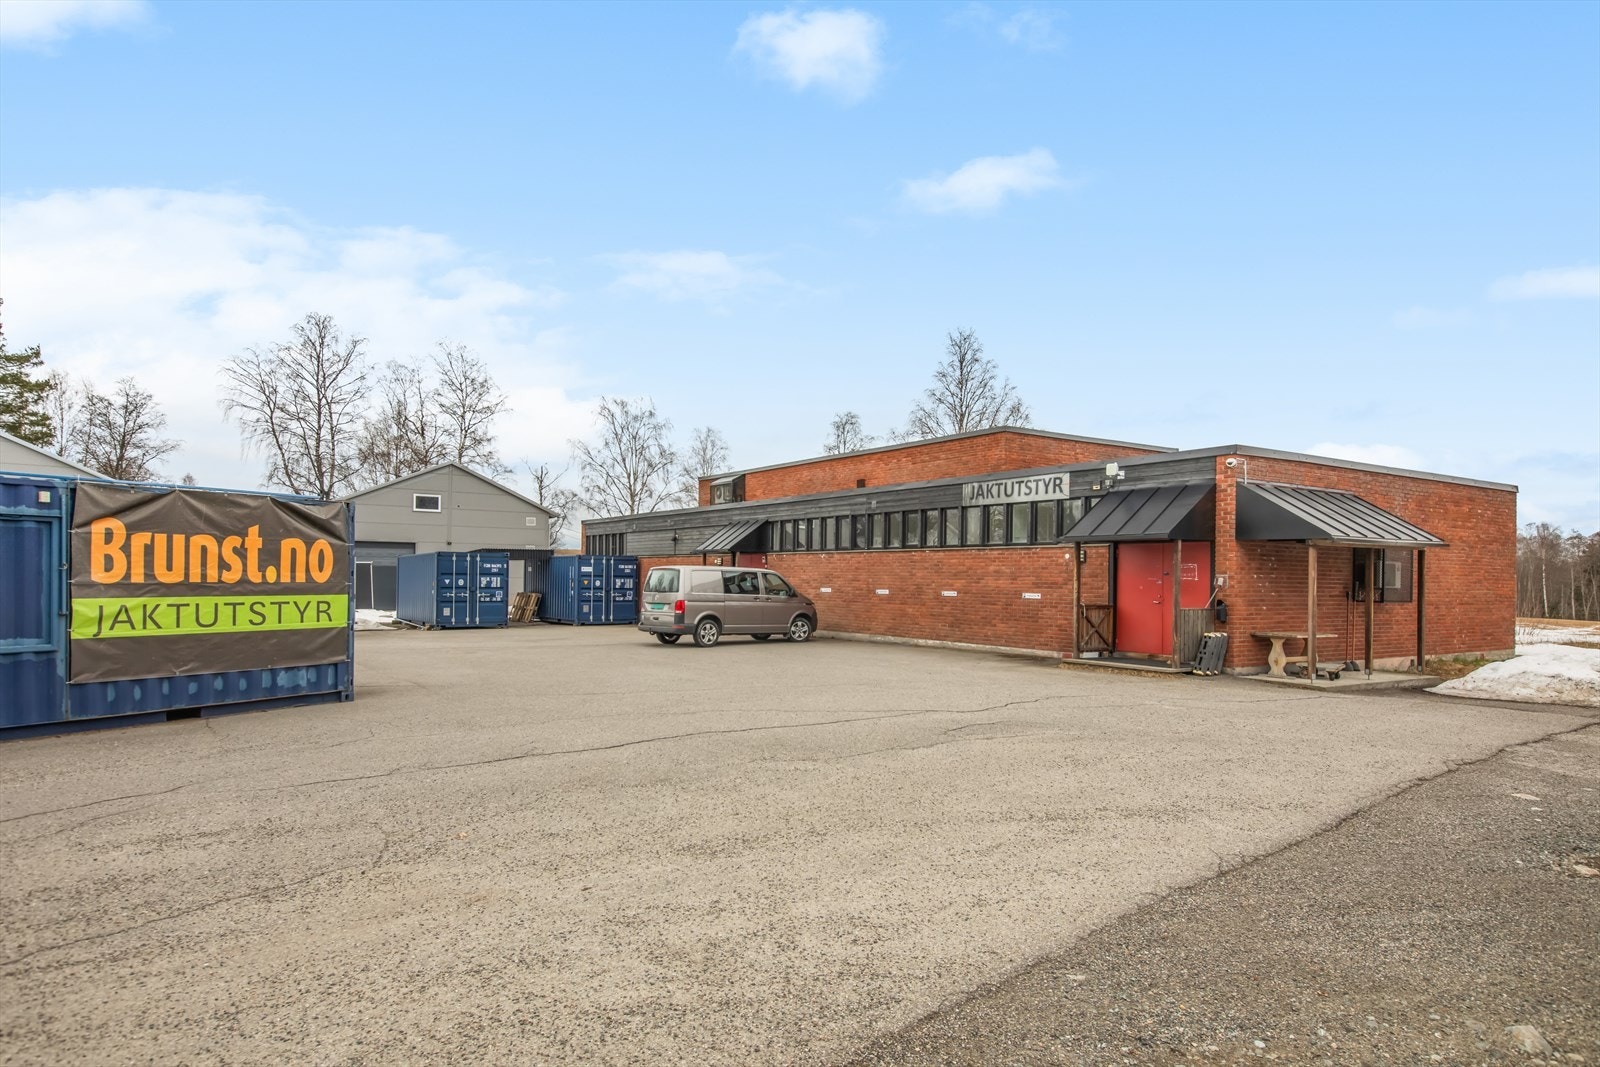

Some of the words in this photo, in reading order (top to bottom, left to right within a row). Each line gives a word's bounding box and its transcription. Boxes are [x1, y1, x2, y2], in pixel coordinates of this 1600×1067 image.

[970, 476, 1063, 500] JAKTUTSTYR
[90, 517, 334, 584] Brunst.no
[93, 600, 333, 637] JAKTUTSTYR
